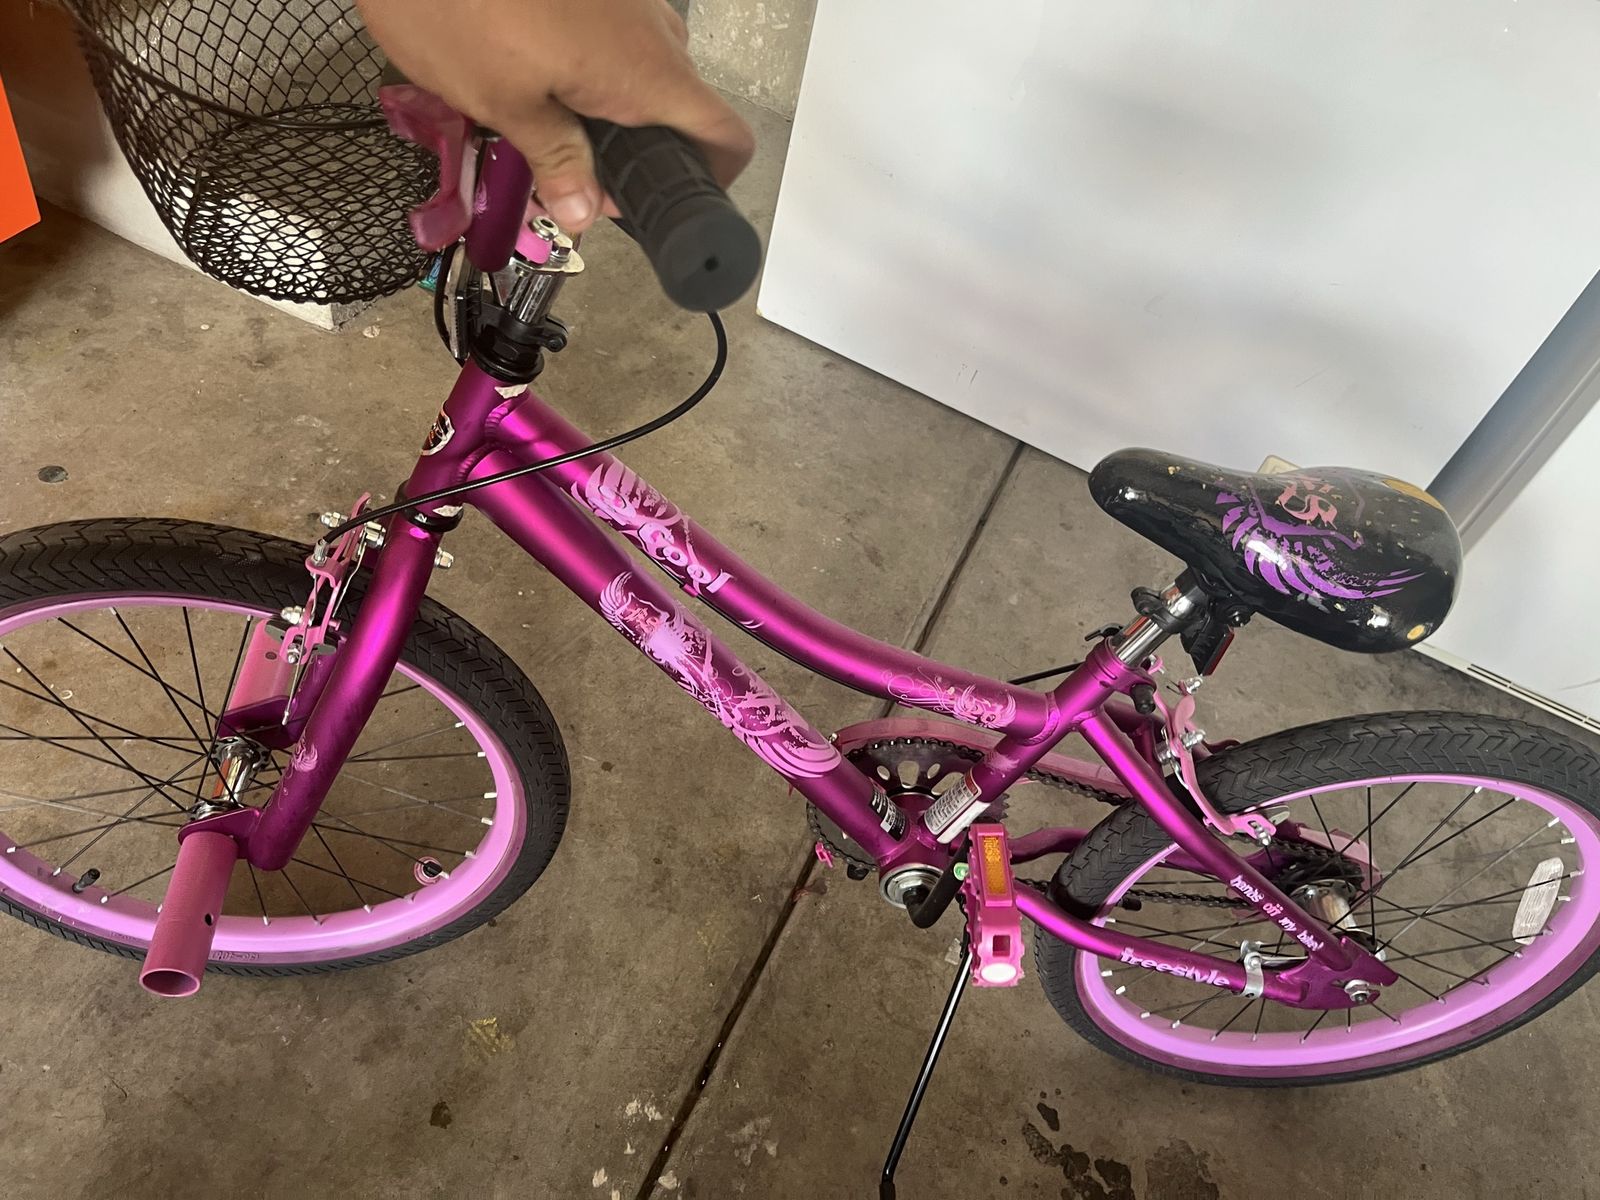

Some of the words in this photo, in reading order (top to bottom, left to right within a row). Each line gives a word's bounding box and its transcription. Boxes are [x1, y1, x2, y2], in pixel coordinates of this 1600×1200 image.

[1230, 875, 1264, 903] hands
[1278, 916, 1297, 932] my
[1120, 946, 1230, 986] freestyle
